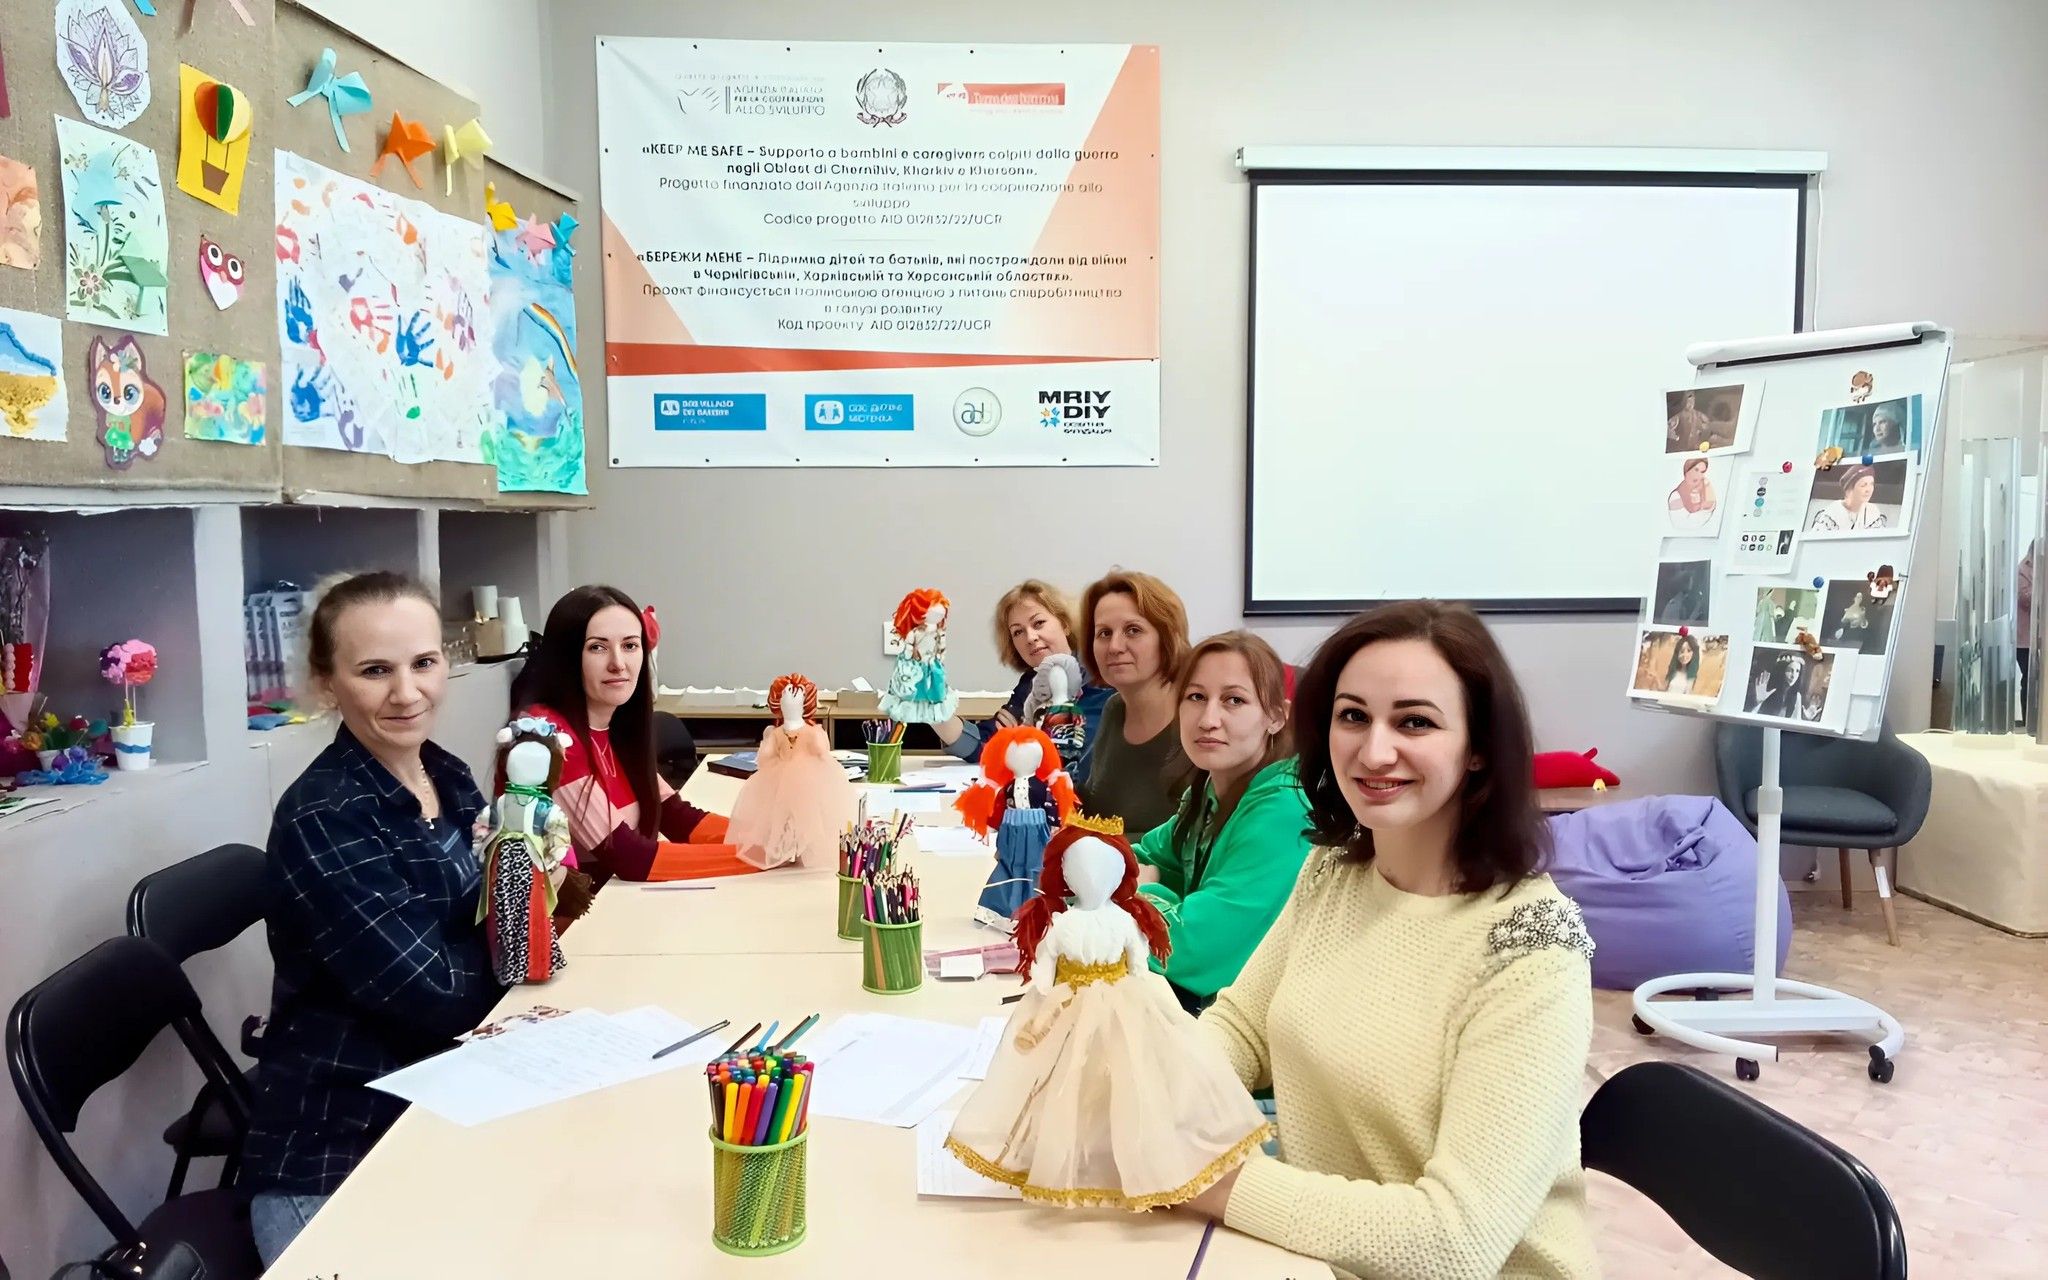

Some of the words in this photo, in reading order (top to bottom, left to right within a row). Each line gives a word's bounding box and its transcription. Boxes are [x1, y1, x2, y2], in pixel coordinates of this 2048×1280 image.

[688, 145, 707, 156] ME
[712, 146, 743, 157] SAFE
[760, 147, 823, 159] Supporto
[829, 150, 836, 158] a
[841, 148, 897, 159] bambini
[902, 150, 908, 159] e
[913, 149, 985, 161] caregivers
[989, 150, 1031, 161] colpiti
[1036, 149, 1069, 159] dalla
[1075, 151, 1119, 161] guerra
[727, 163, 760, 176] negli
[764, 163, 809, 174] Oblast
[815, 164, 826, 174] di
[833, 164, 899, 176] Chernihiv,
[904, 166, 953, 176] Kharkiv
[958, 168, 965, 176] e
[660, 178, 718, 191] Progetto
[724, 180, 792, 191] finanziato
[883, 182, 934, 192] Italiana
[939, 183, 961, 195] per
[965, 182, 977, 192] la
[982, 182, 1074, 195] cooperazione
[1079, 183, 1102, 193] allo
[764, 214, 812, 225] Codice
[816, 215, 876, 227] progetto
[881, 214, 902, 225] AID
[706, 252, 742, 263] МЕНЕ
[829, 253, 864, 266] дітей
[869, 256, 884, 265] та
[948, 255, 965, 265] які
[970, 256, 1064, 266] постраждали
[1069, 256, 1087, 266] від
[1092, 256, 1126, 265] війни
[694, 271, 700, 279] в
[804, 271, 884, 282] Харківській
[890, 273, 902, 282] та
[908, 272, 992, 283] Херсонській
[778, 319, 802, 330] Код
[871, 320, 892, 330] AID
[1039, 391, 1110, 404] MRIY
[1064, 406, 1110, 418] DIY
